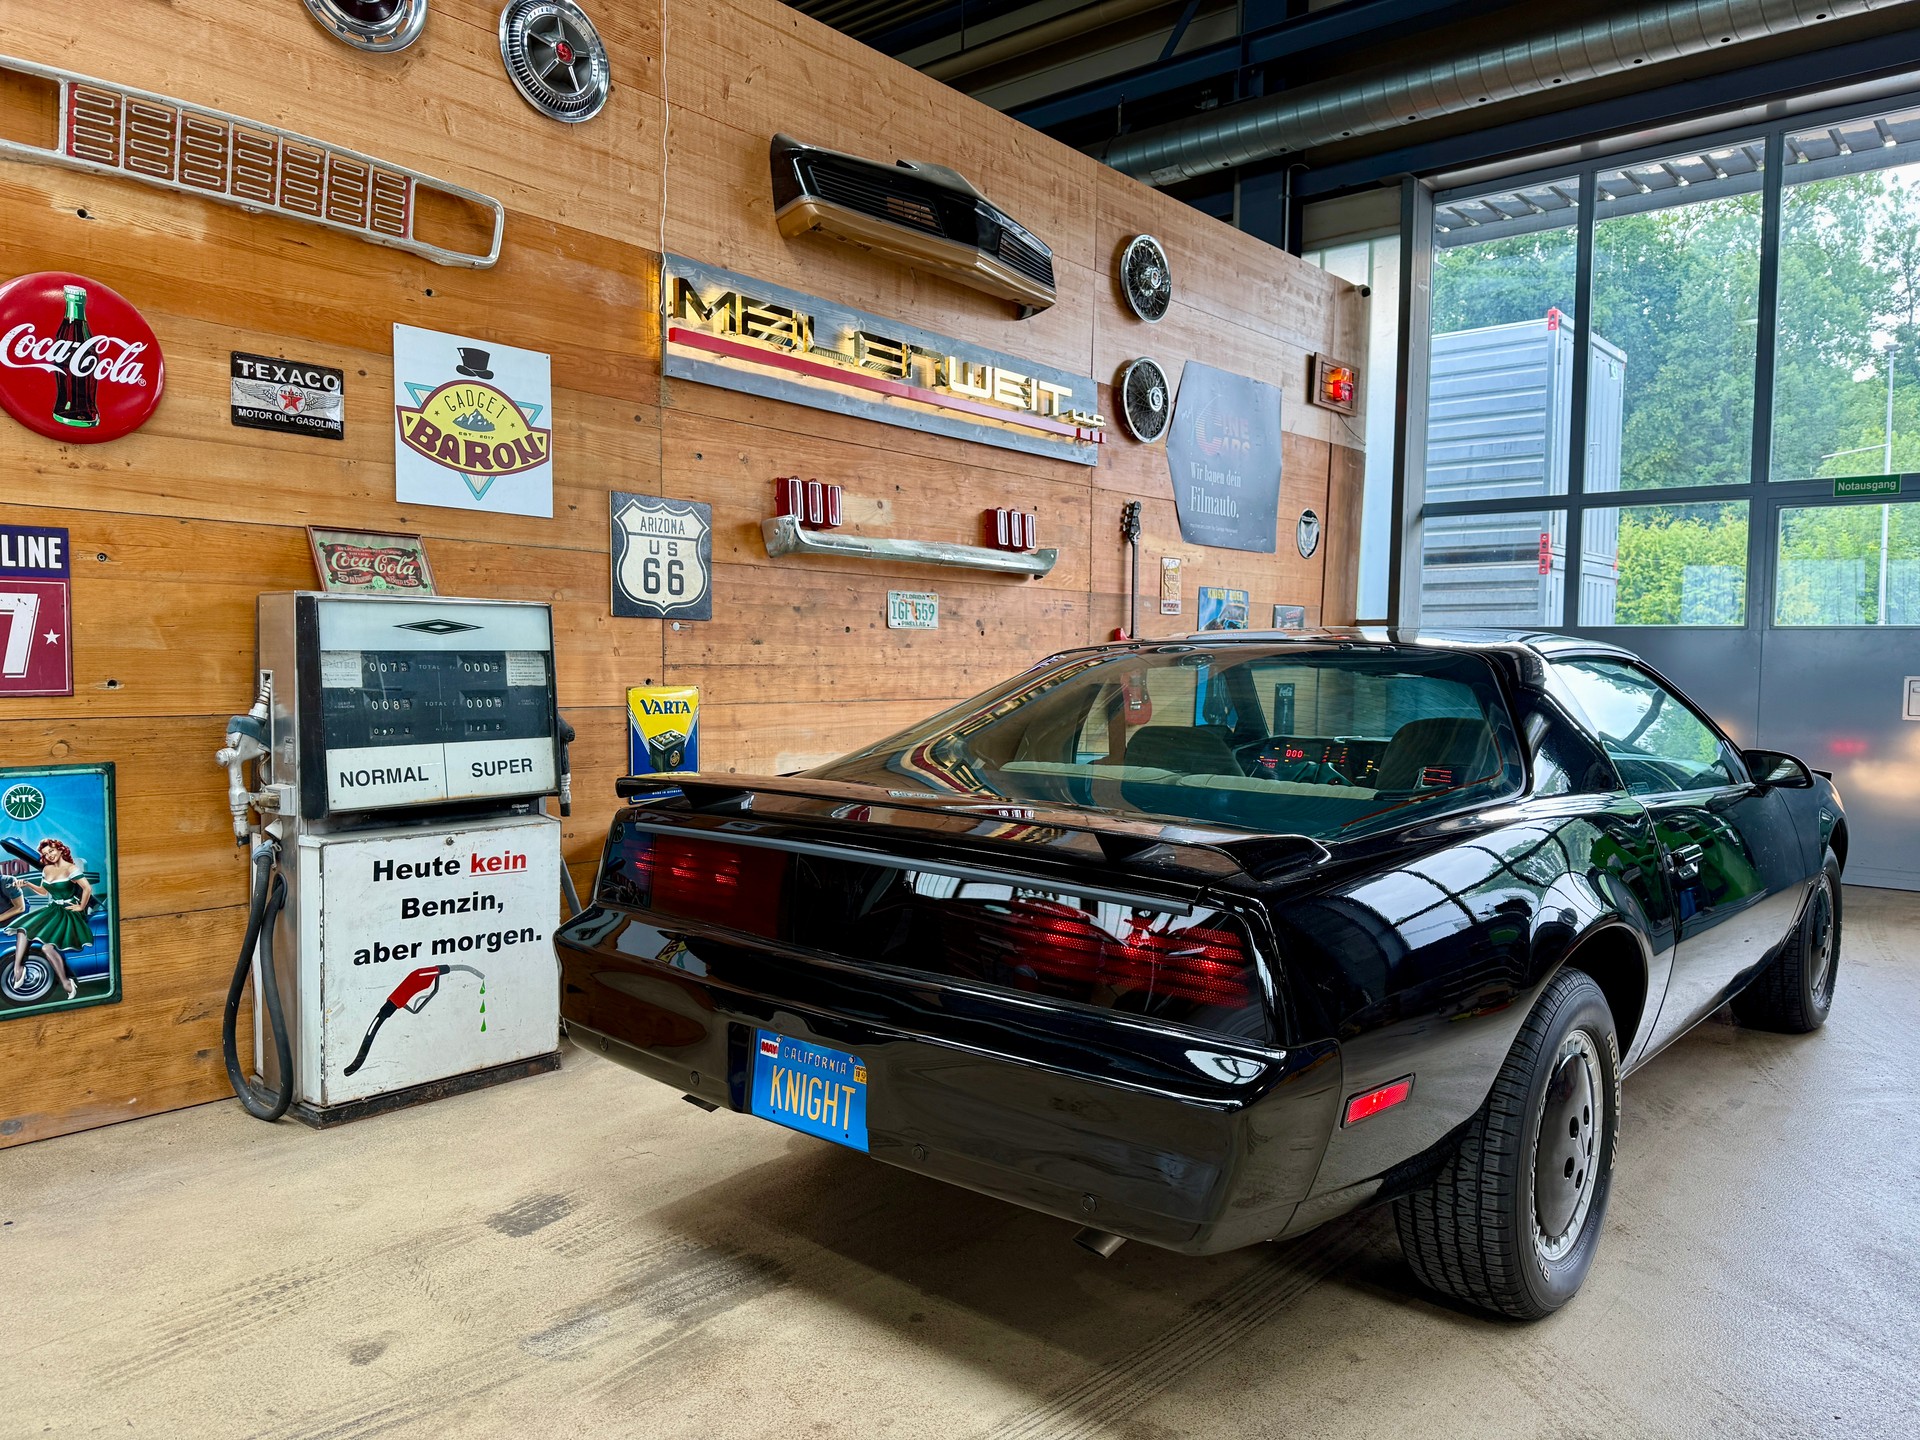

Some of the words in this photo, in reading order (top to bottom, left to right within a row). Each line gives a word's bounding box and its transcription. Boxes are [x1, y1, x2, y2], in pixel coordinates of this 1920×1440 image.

[0, 323, 148, 385] Coca-Cola
[237, 360, 340, 391] TEXACO
[238, 408, 273, 421] MOTOR
[274, 413, 290, 423] OIL
[296, 416, 341, 430] GASOLINE
[444, 389, 508, 419] GADGET
[407, 416, 545, 470] BARON
[1190, 461, 1204, 481] Wir
[1204, 465, 1225, 486] bauen
[1226, 470, 1242, 488] dein
[1838, 479, 1897, 492] Notausgang
[1190, 485, 1240, 519] Filmauto.
[640, 516, 685, 535] ARIZONA
[1, 534, 63, 569] LINE
[643, 557, 684, 595] 66
[640, 699, 692, 715] VARTA
[340, 765, 430, 788] NORMAL
[471, 757, 534, 778] SUPER
[10, 793, 37, 804] NTK
[373, 856, 461, 882] Heute
[470, 850, 527, 874] kein
[401, 891, 504, 920] Benzin,
[353, 942, 423, 966] aber
[431, 927, 542, 953] morgen.
[784, 1046, 847, 1075] CALIFORNIA
[770, 1065, 856, 1131] KNIGHT
